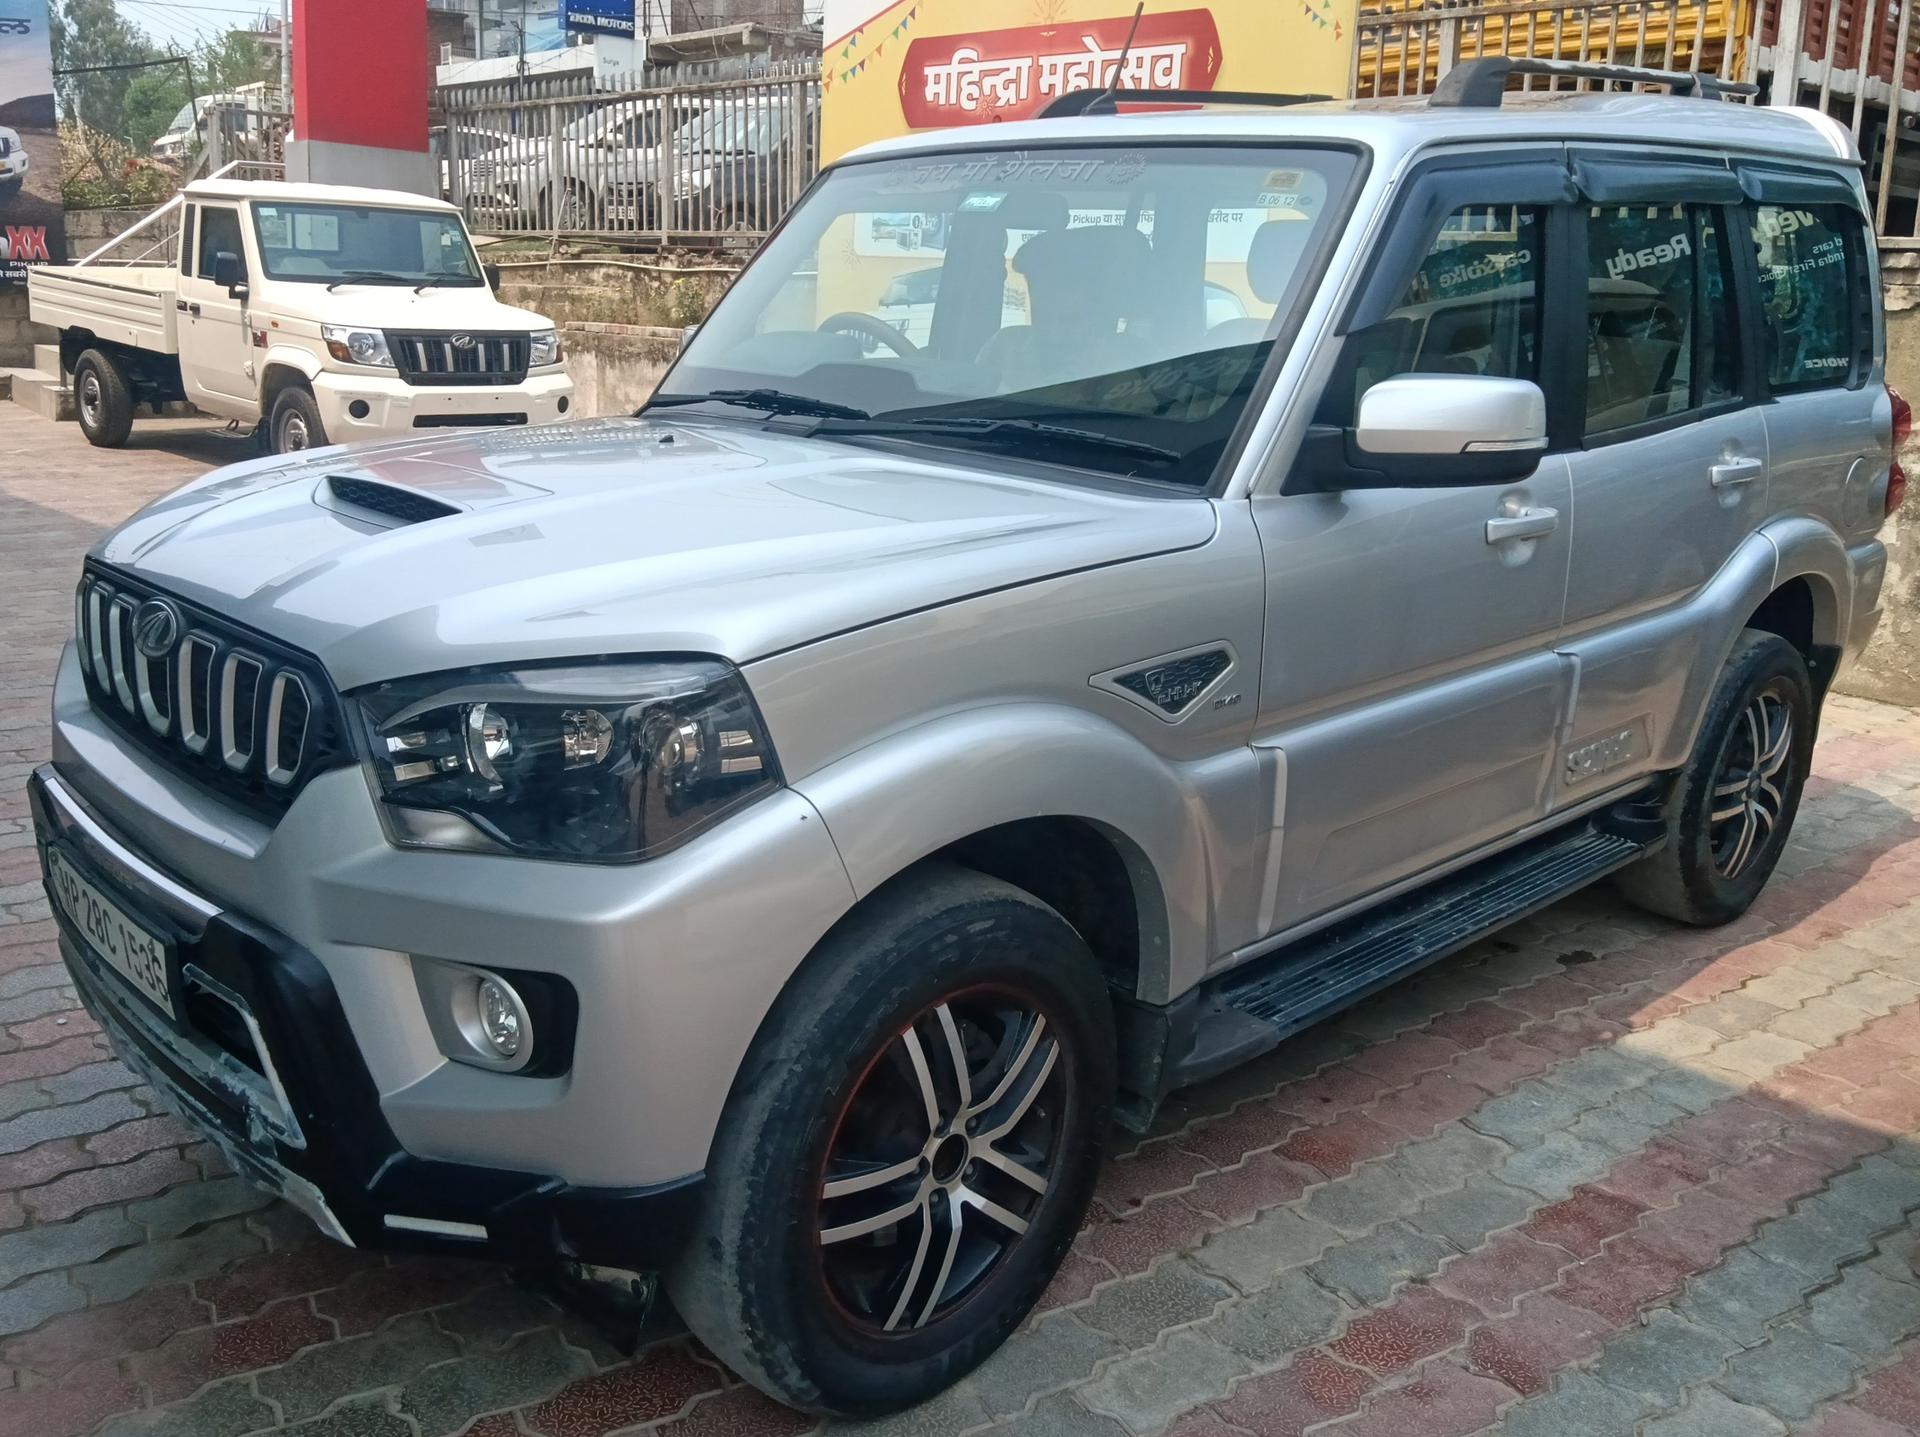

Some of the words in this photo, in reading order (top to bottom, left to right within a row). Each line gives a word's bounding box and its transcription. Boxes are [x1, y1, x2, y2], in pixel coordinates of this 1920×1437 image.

[597, 17, 634, 31] MOTORS
[1072, 214, 1101, 226] Pickup
[1231, 212, 1243, 222] पर
[59, 866, 79, 923] HP
[82, 889, 117, 955] 28C
